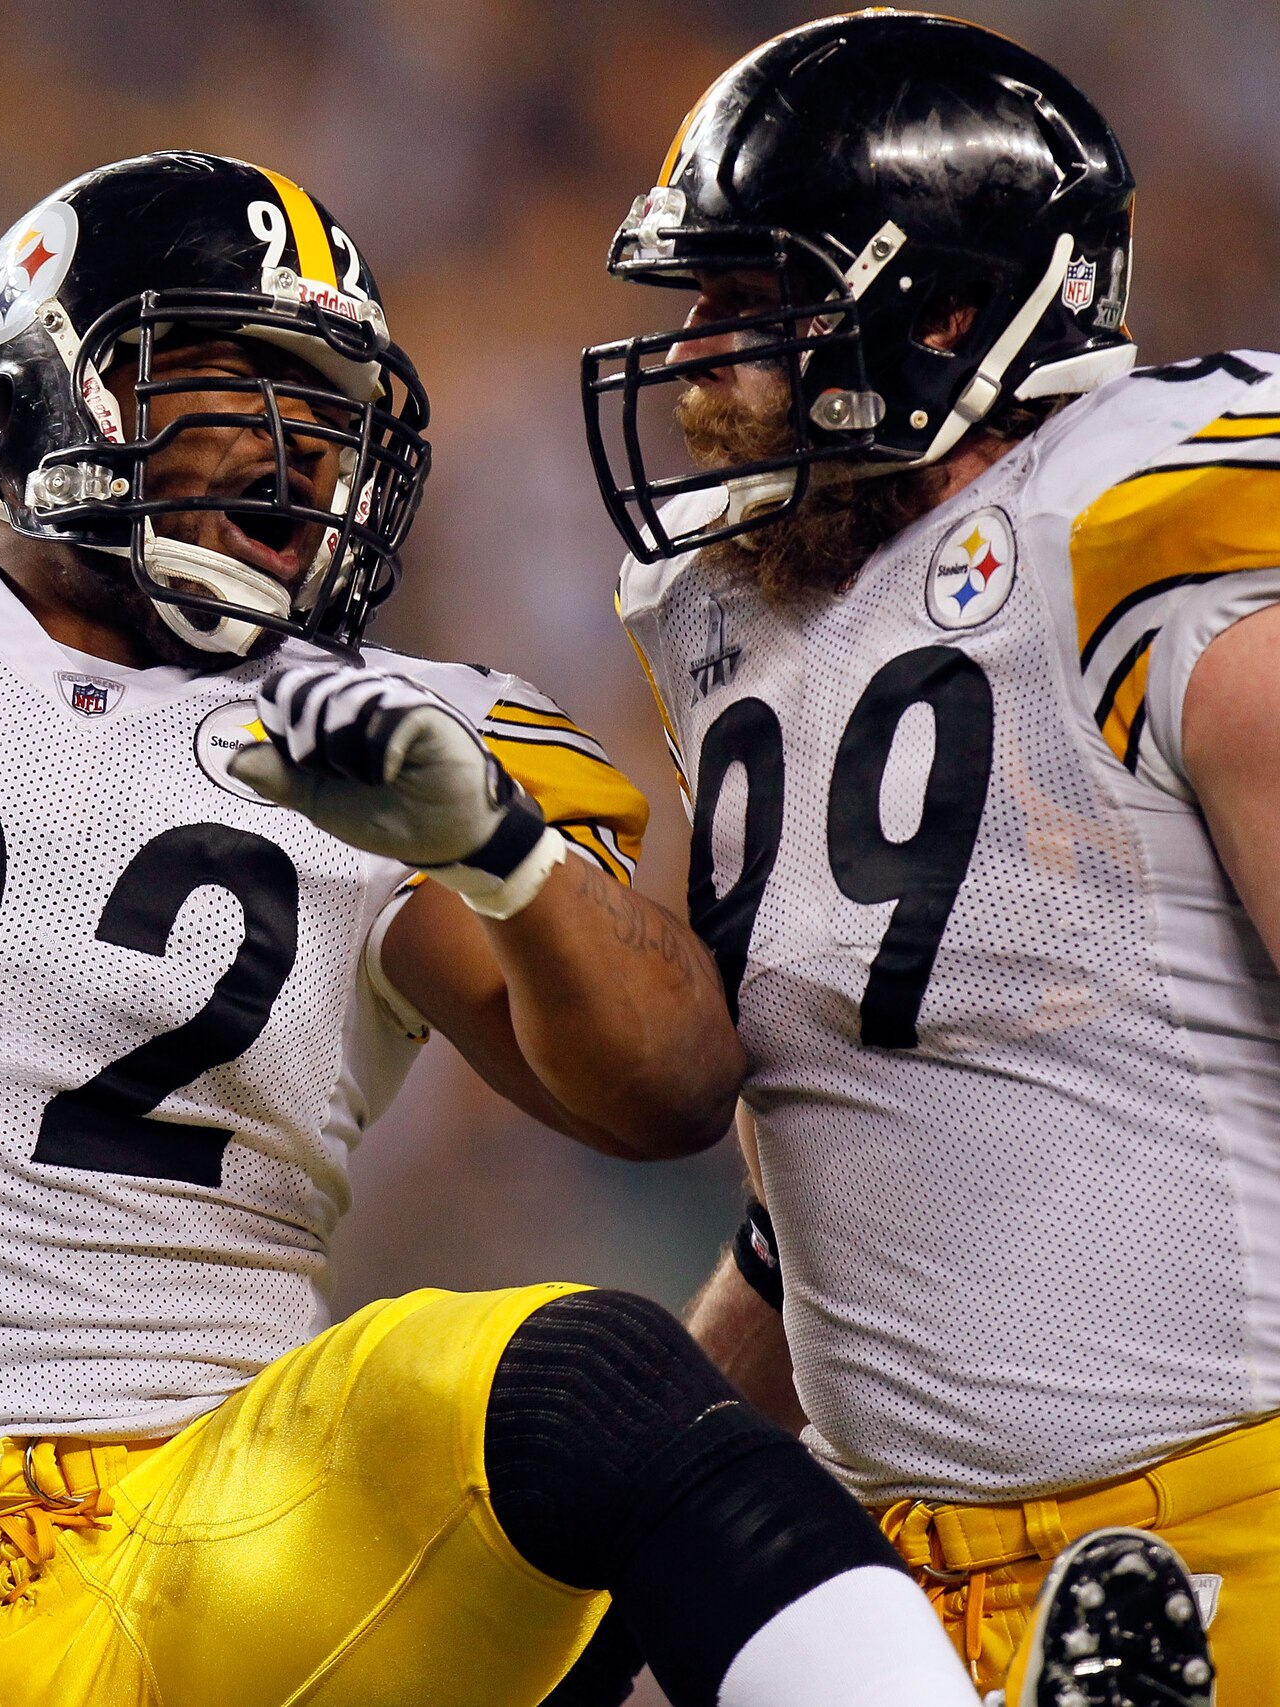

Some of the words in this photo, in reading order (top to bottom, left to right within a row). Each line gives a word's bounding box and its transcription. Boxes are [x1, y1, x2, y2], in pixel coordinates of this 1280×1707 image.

[247, 200, 369, 302] 92
[298, 283, 357, 321] Riddell
[1067, 281, 1089, 303] NFL
[82, 376, 118, 443] Ridd
[937, 562, 968, 578] Steelers
[61, 674, 122, 692] EQUIPMENT
[74, 694, 104, 712] NFL
[210, 735, 246, 751] Steele
[687, 645, 993, 1048] 99
